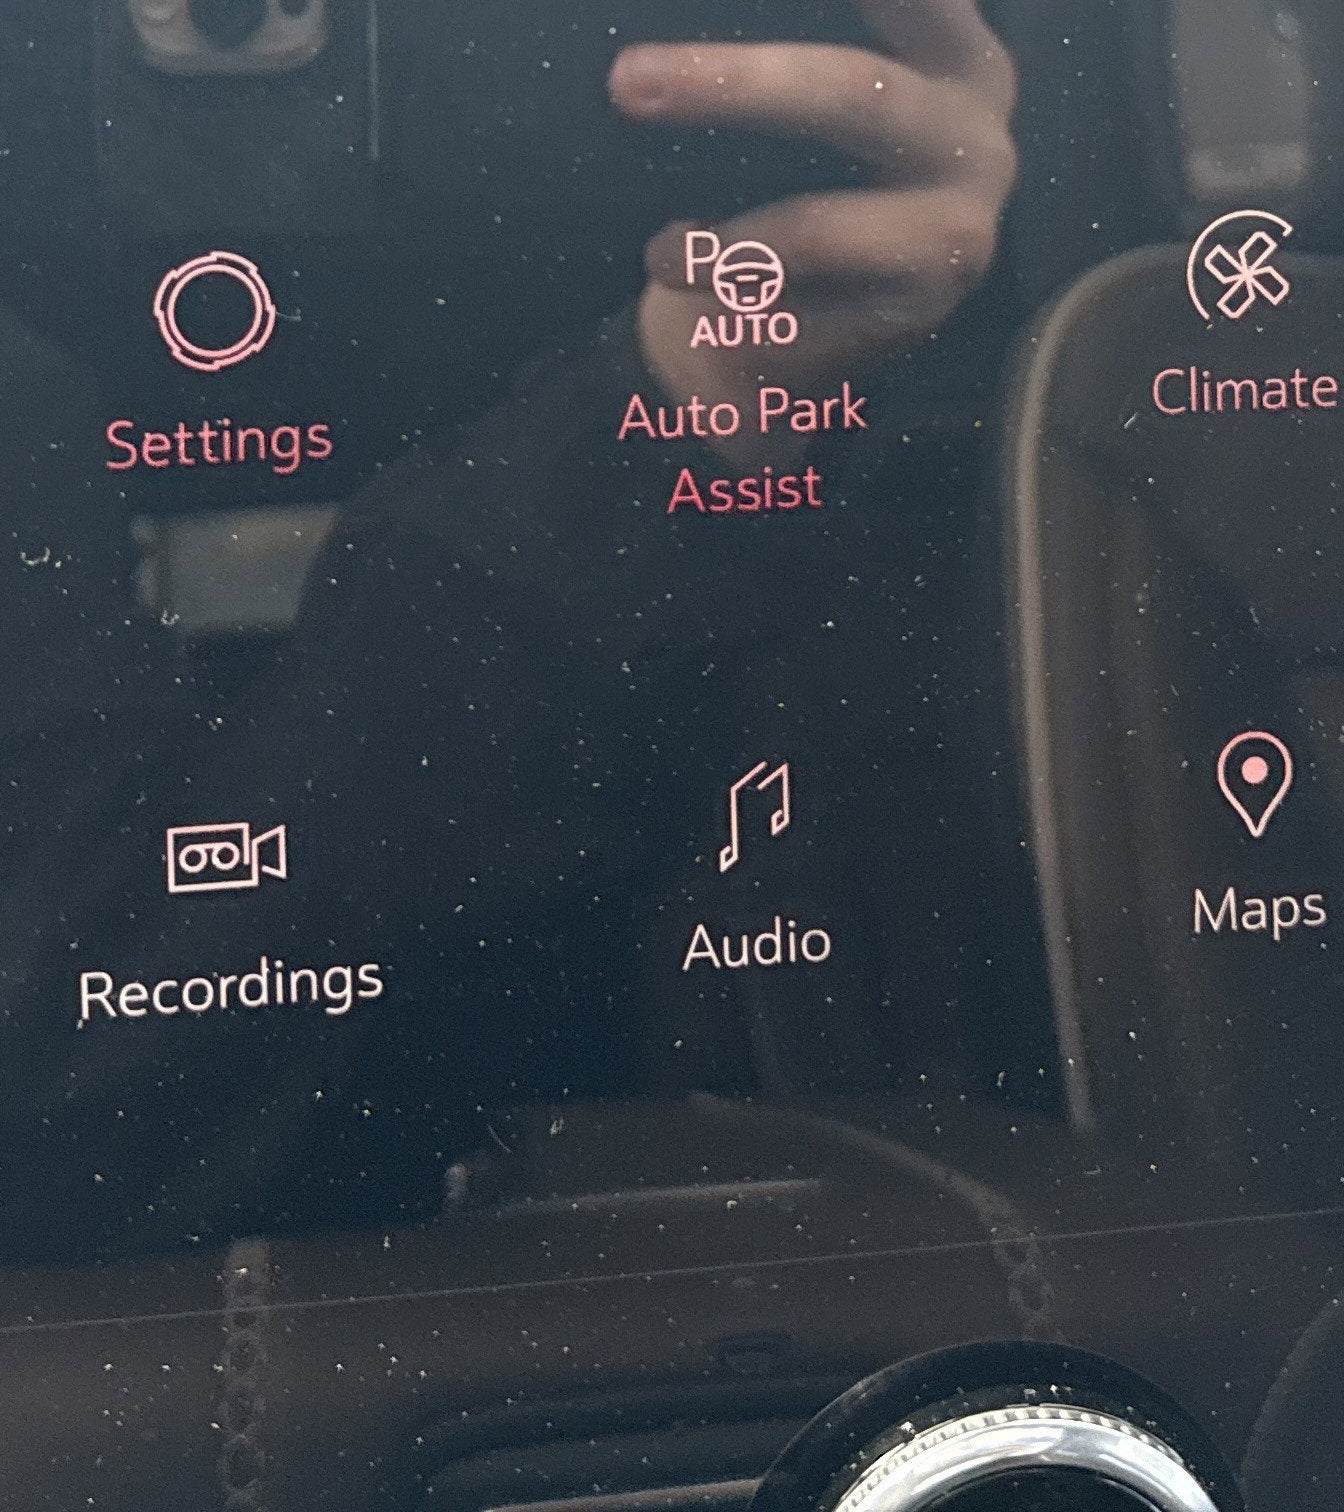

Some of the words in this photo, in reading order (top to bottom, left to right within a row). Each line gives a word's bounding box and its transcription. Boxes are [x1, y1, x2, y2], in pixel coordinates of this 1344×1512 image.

[690, 311, 798, 347] AUTO
[617, 392, 741, 441] Auto
[758, 382, 869, 436] Park
[1152, 366, 1340, 415] Climate
[105, 418, 334, 474] Settings
[666, 466, 822, 514] Assist
[1192, 885, 1328, 941] Maps
[682, 916, 832, 972] Audio
[78, 956, 385, 1020] Recordings
